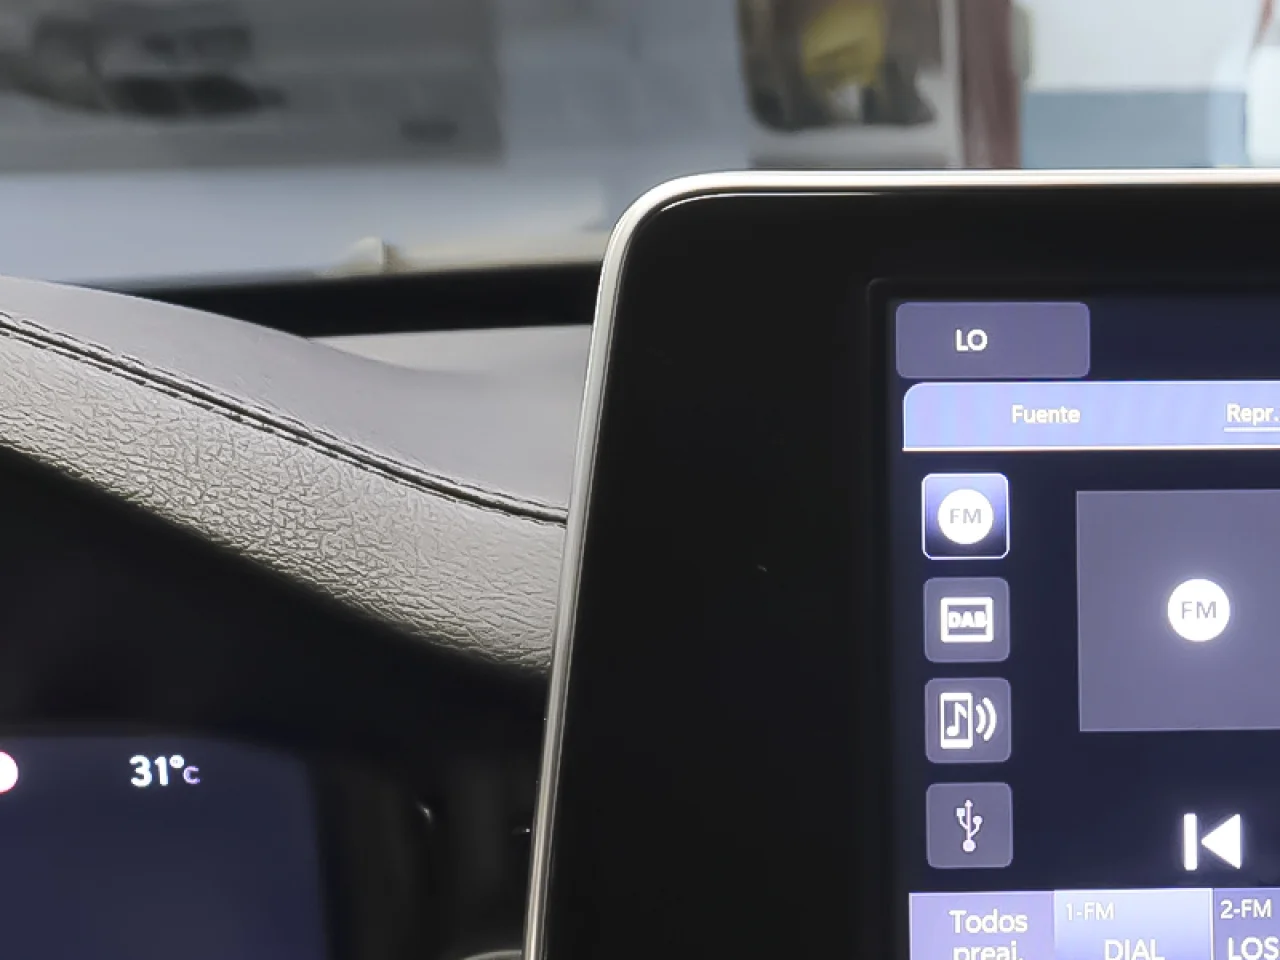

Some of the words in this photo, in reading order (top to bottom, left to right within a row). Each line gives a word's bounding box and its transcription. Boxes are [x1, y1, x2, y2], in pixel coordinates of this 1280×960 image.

[955, 328, 988, 351] LO
[1012, 404, 1081, 424] Fuente
[949, 508, 982, 525] FM
[948, 610, 987, 628] DAB
[1181, 602, 1217, 619] FM
[1066, 903, 1114, 920] 1-FM
[1220, 900, 1272, 919] 2-FM
[950, 909, 1028, 932] Todos
